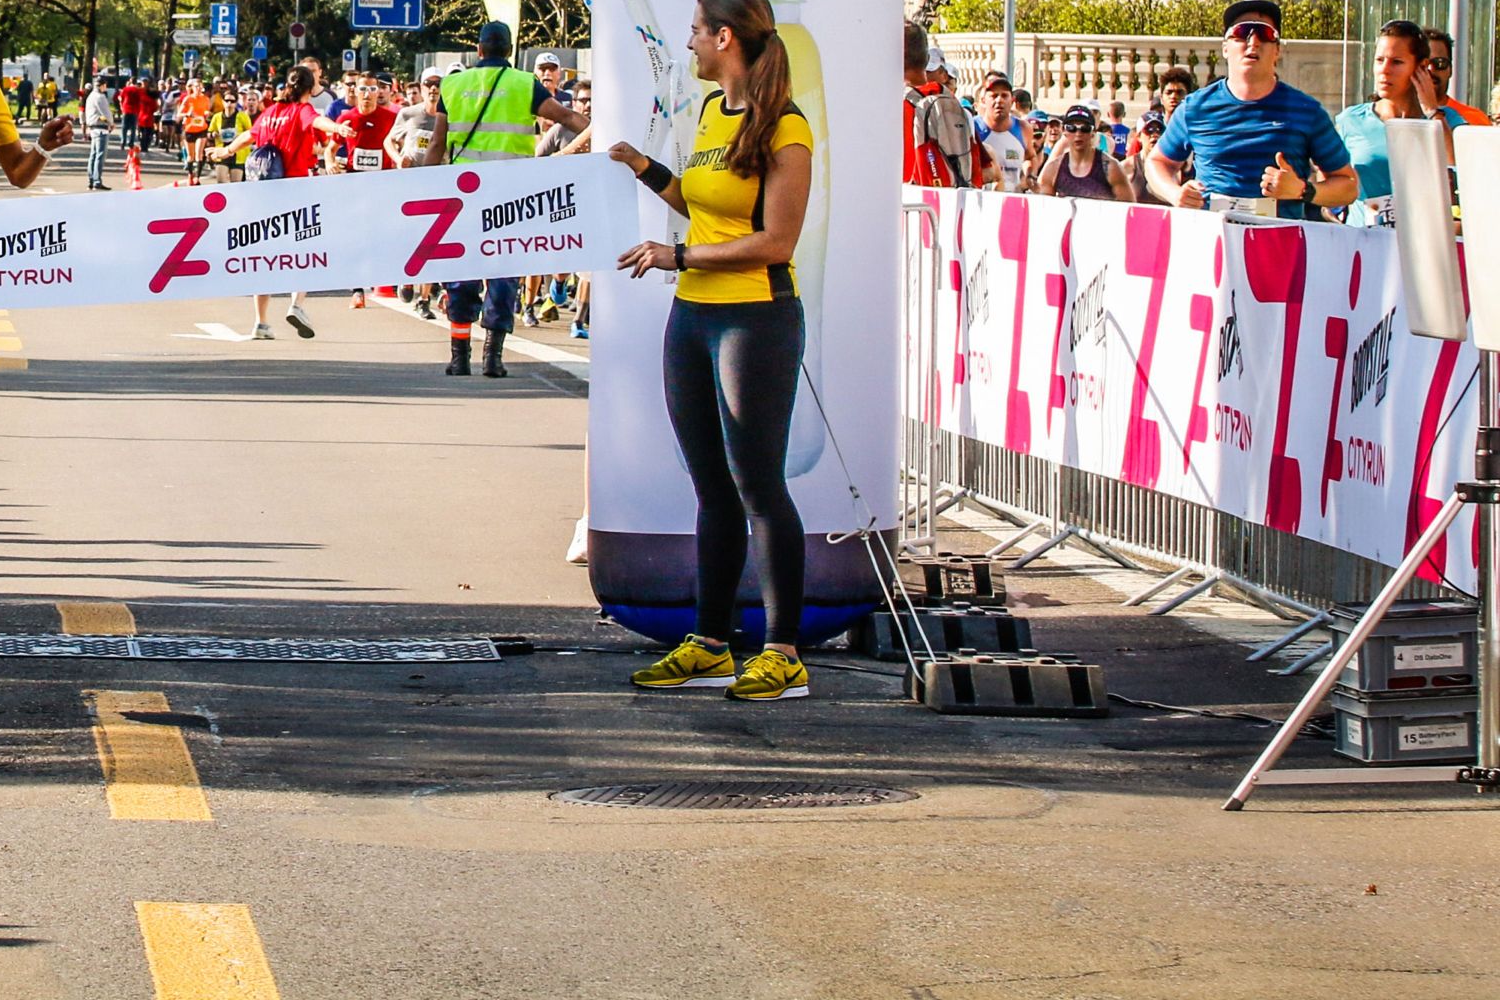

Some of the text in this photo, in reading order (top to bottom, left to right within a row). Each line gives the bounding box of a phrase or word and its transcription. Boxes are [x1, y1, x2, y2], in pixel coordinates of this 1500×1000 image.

[218, 5, 230, 22] P
[481, 183, 576, 232] BODYSTYLE
[549, 206, 576, 223] SPORT
[227, 203, 321, 250] BODYSTYLE
[295, 226, 322, 242] SPORT
[40, 242, 67, 258] SPORT
[480, 233, 583, 256] CITYRUN
[225, 252, 328, 274] CITYRUN
[1348, 435, 1387, 487] CITYRUN
[1397, 652, 1404, 661] 4
[1403, 733, 1418, 744] 15
